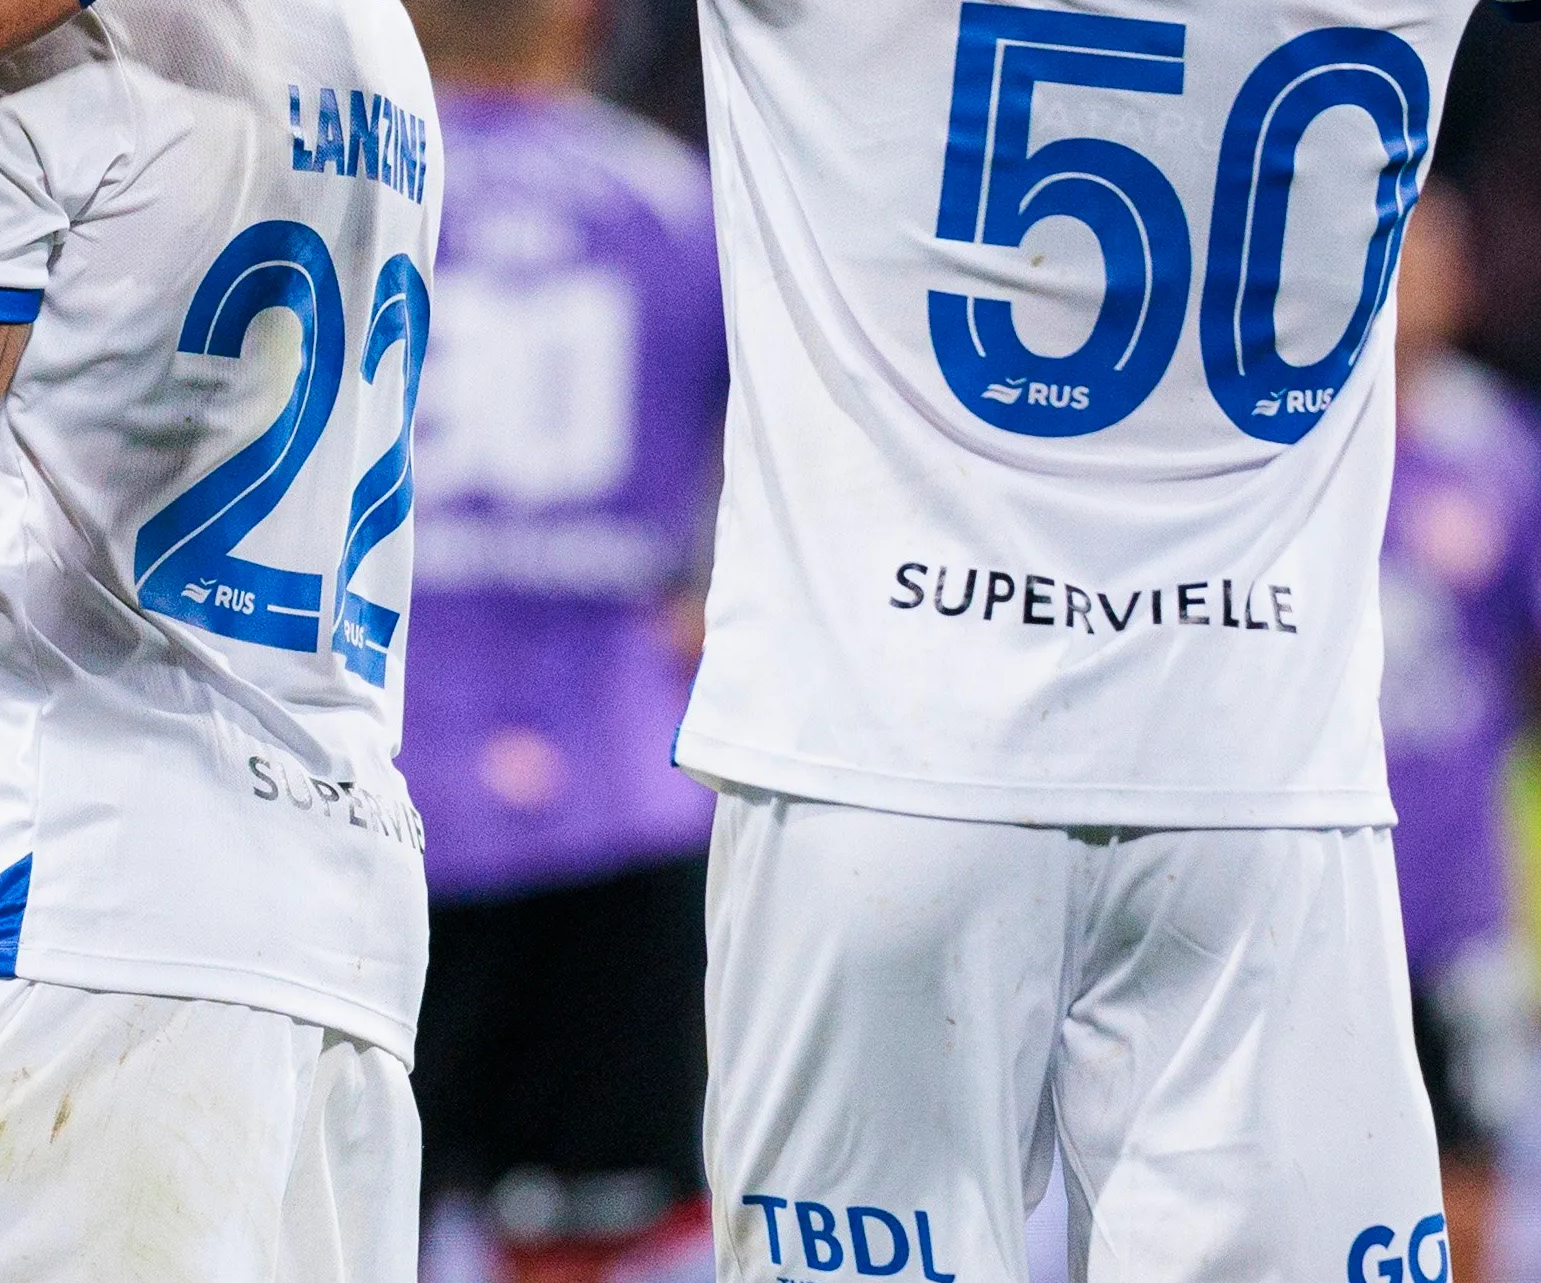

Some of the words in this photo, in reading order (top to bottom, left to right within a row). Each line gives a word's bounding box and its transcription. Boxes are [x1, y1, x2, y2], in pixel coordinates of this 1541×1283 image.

[927, 2, 1431, 444] 50
[1027, 382, 1090, 410] RUS
[1286, 387, 1334, 414] RUS
[134, 219, 431, 689] 22
[214, 584, 256, 615] RUS
[889, 561, 1298, 634] SUPERVIELLE
